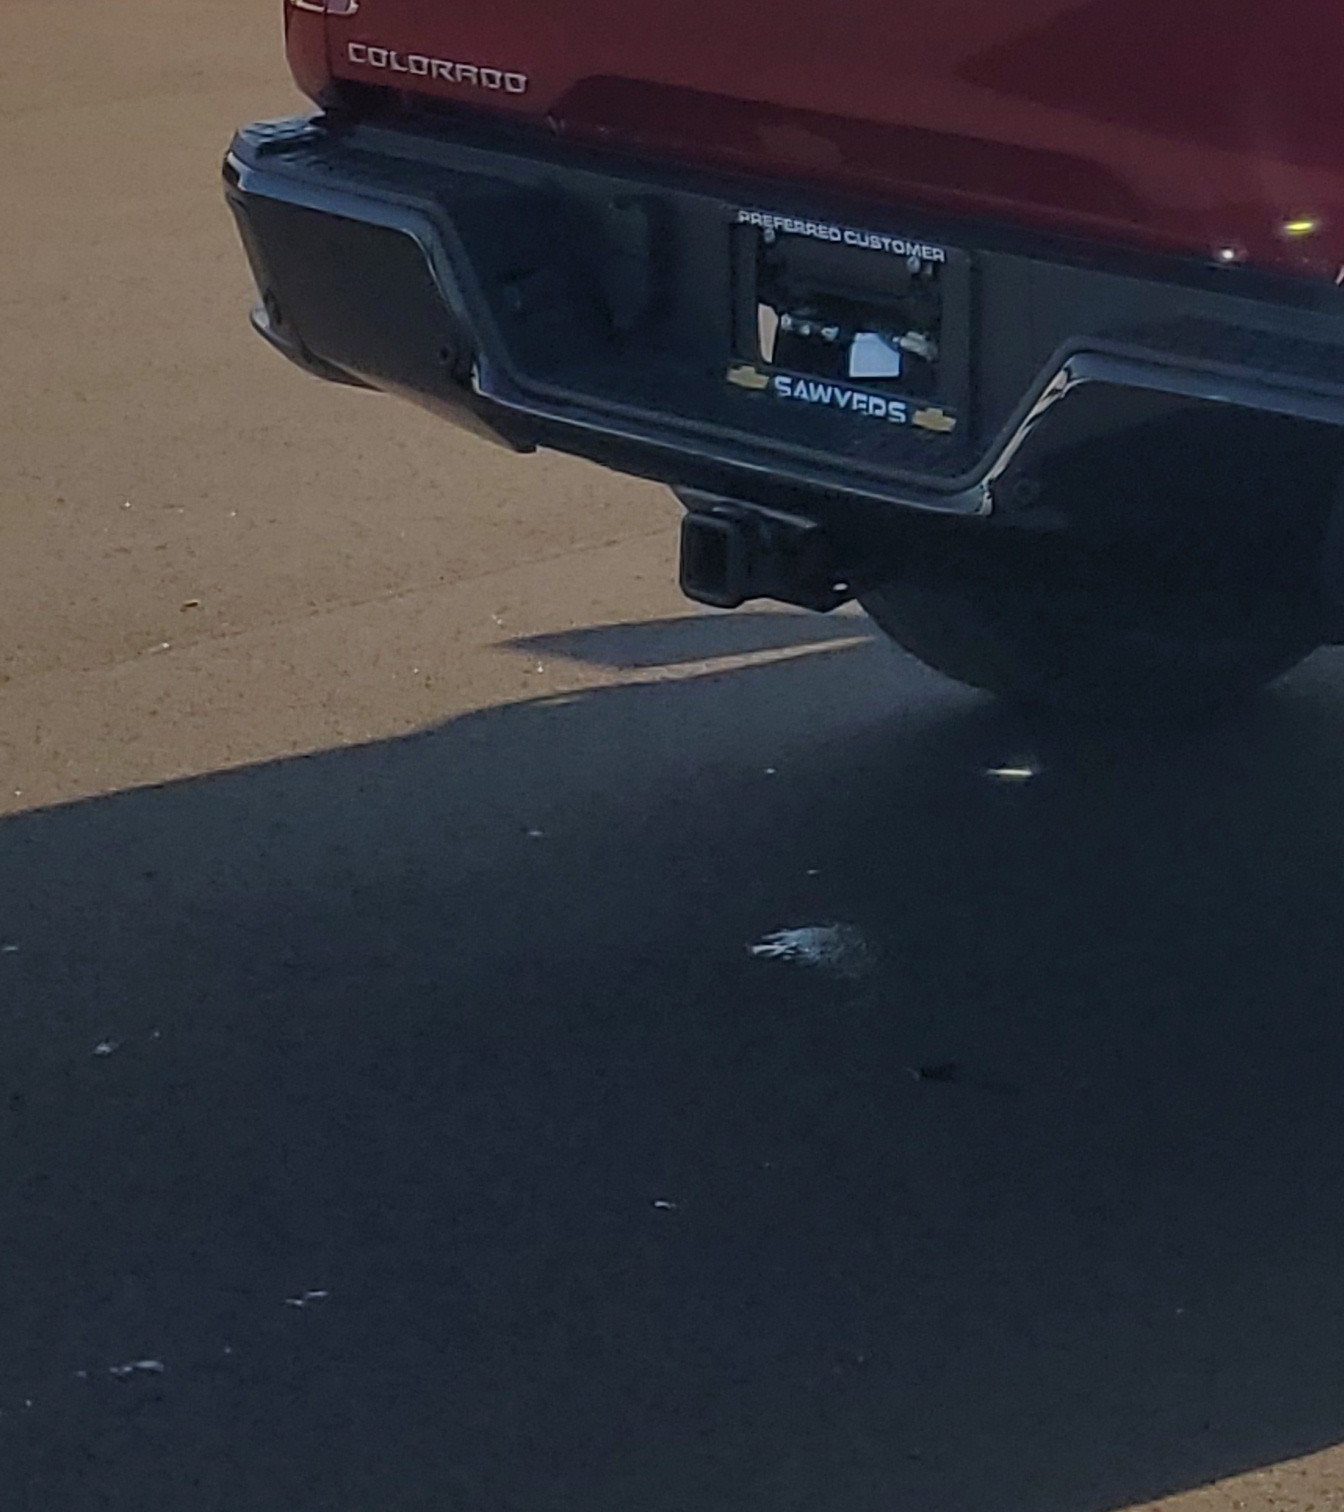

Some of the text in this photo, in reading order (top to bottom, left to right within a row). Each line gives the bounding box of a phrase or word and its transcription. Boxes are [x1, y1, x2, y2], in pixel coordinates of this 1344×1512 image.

[348, 42, 528, 93] COLORADO
[738, 210, 946, 263] PREFERRED CUSTOMER
